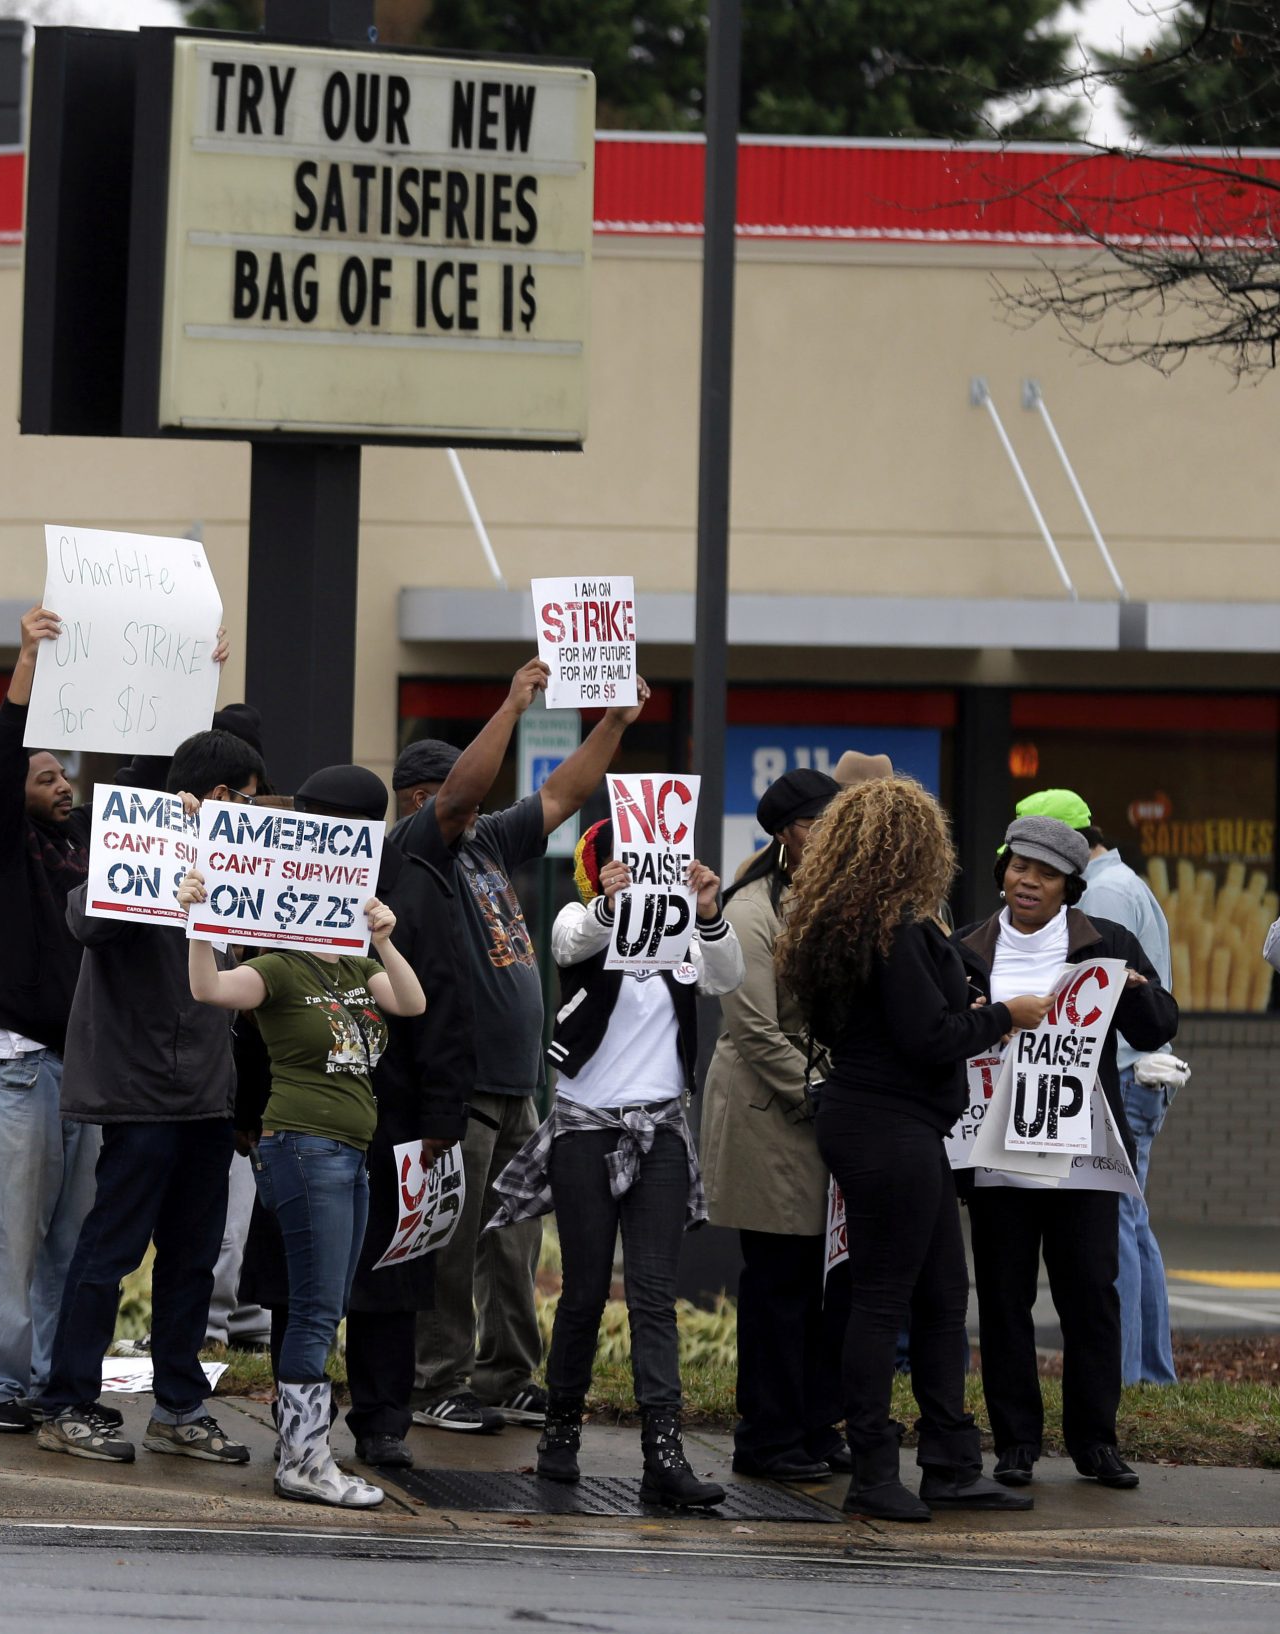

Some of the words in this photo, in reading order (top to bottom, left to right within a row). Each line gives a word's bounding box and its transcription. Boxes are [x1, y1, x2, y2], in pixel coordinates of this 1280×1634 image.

[211, 62, 296, 136] TRY
[322, 71, 411, 146] OUR
[451, 80, 537, 153] NEW
[294, 160, 539, 245] SATISFRIES
[233, 250, 319, 324] BAG
[339, 256, 393, 327] OF
[415, 260, 479, 331] ICE
[59, 535, 176, 595] Charlotte
[574, 582, 579, 598] I
[581, 582, 597, 598] AM
[599, 581, 612, 597] ON
[541, 600, 636, 644] STRIKE
[56, 621, 93, 668] ON
[122, 620, 209, 675] STRIKE
[558, 646, 580, 662] FOR
[582, 646, 597, 662] MY
[600, 645, 631, 662] FUTURE
[560, 665, 581, 682] FOR
[583, 665, 598, 682] MY
[601, 664, 632, 681] FAMILY
[580, 684, 601, 700] FOR
[604, 681, 617, 702] $15
[53, 682, 95, 737] for
[113, 684, 160, 738] $15
[209, 809, 373, 859] AMERICA
[612, 779, 693, 846] NC
[103, 831, 169, 856] CAN'T
[107, 862, 162, 899] ON
[208, 851, 276, 877] CAN'T
[281, 860, 370, 888] SURVIVE
[210, 884, 265, 921] ON
[274, 885, 359, 930] $7.25
[616, 892, 690, 959] UP
[1013, 1071, 1084, 1140] UP
